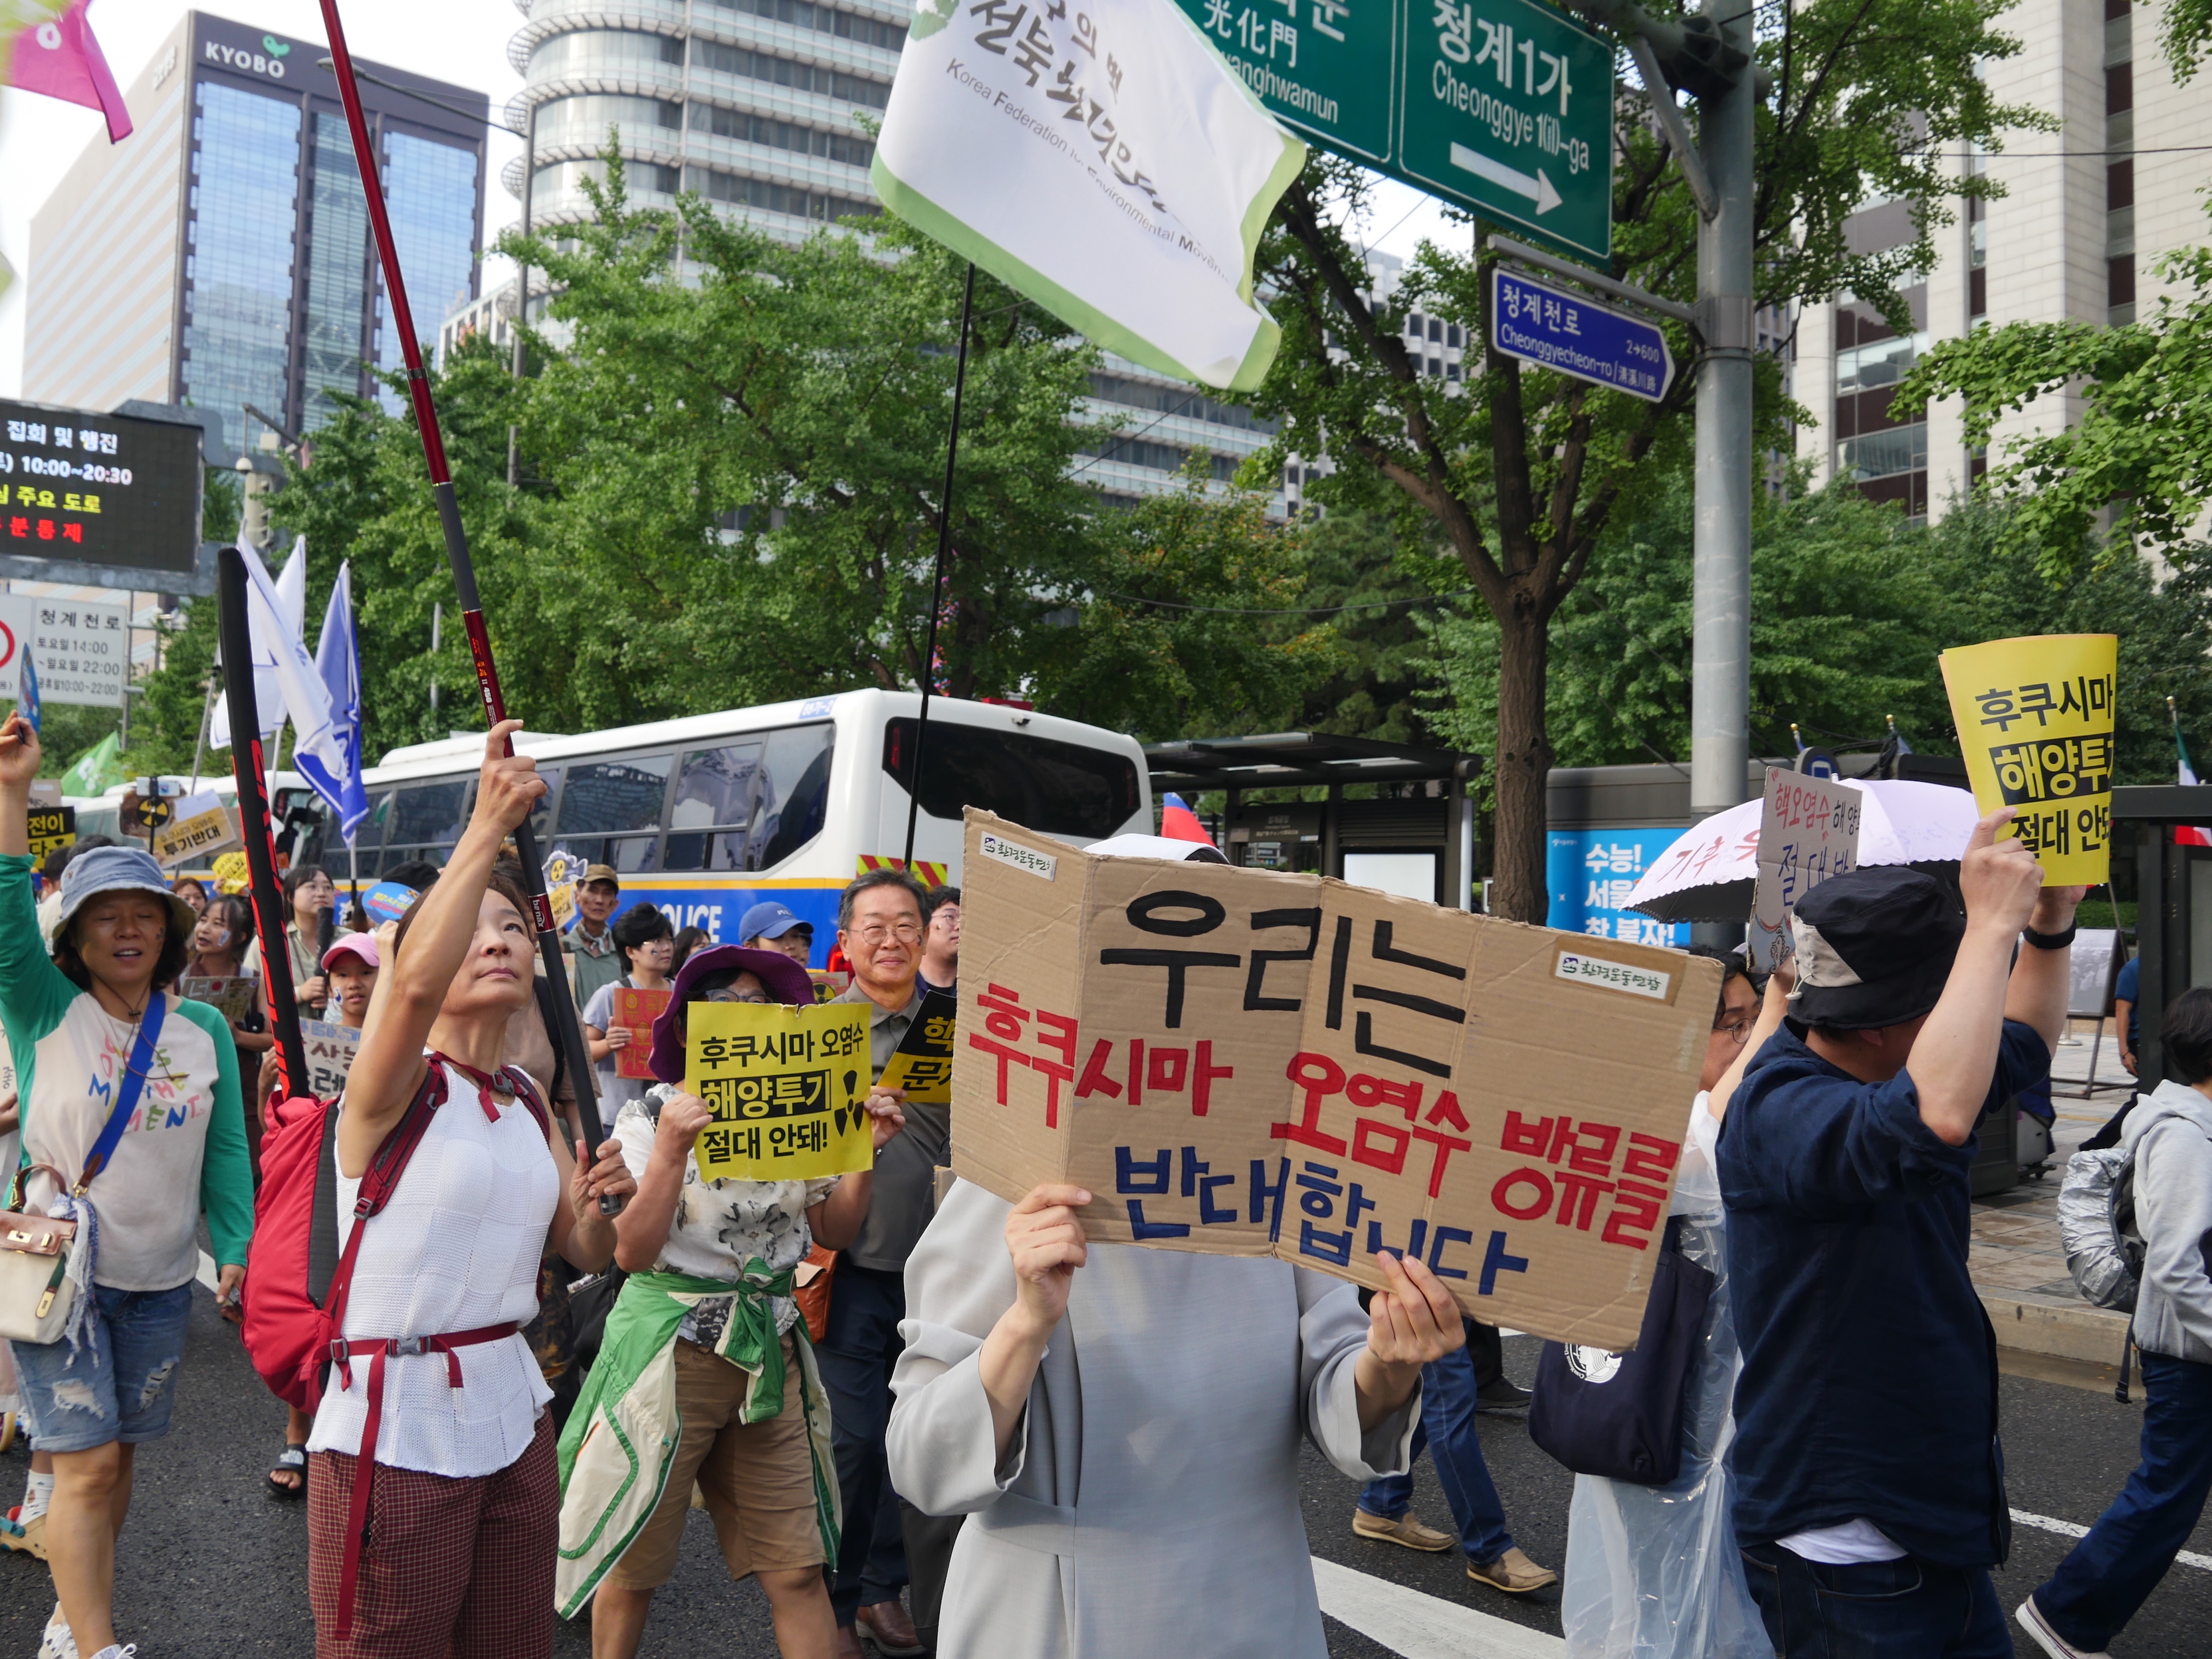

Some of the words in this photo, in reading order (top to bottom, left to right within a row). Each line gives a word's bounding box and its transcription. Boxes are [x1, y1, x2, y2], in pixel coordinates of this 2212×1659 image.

[1204, 0, 1298, 68] 光化門
[205, 41, 284, 78] KYOBO
[1433, 0, 1572, 116] 청계1가
[946, 58, 992, 100] Korea
[994, 91, 1068, 153] Federation
[1219, 49, 1338, 124] anghwamun
[1433, 60, 1533, 146] Cheonggye
[1503, 284, 1581, 336] 청계천로
[7, 420, 47, 445] 집회
[55, 427, 72, 448] 및
[79, 429, 118, 455] 행진
[21, 455, 132, 485] 10:00~20:30
[17, 486, 56, 507] 주요
[62, 493, 102, 513] 도로
[37, 637, 68, 651] 토요일
[72, 639, 108, 655] 14:00
[83, 660, 120, 676] 22:00
[1975, 673, 2113, 732] 후쿠시마
[1775, 783, 1830, 830] 핵오염수
[164, 825, 221, 856] 투기반대
[2011, 808, 2069, 859] 절대
[1585, 843, 1642, 873] 수능!
[1657, 836, 1724, 883] 기후
[532, 899, 544, 928] banax
[1101, 889, 1466, 1078] 우리는
[1581, 961, 1662, 991] 환경운동연합
[625, 994, 669, 1022] 우리
[636, 1022, 653, 1045] 오
[700, 1030, 815, 1069] 후쿠시마
[820, 1022, 863, 1057] 오염수
[924, 1016, 955, 1051] 핵
[702, 1071, 830, 1119] 해양투기
[969, 983, 1233, 1129] 후쿠시마
[1271, 1051, 1472, 1198] 오염수
[1491, 1111, 1680, 1250] 방류를
[703, 1127, 760, 1164] 절대
[769, 1120, 828, 1157] 안돼!
[1115, 1146, 1528, 1295] 반대합니다
